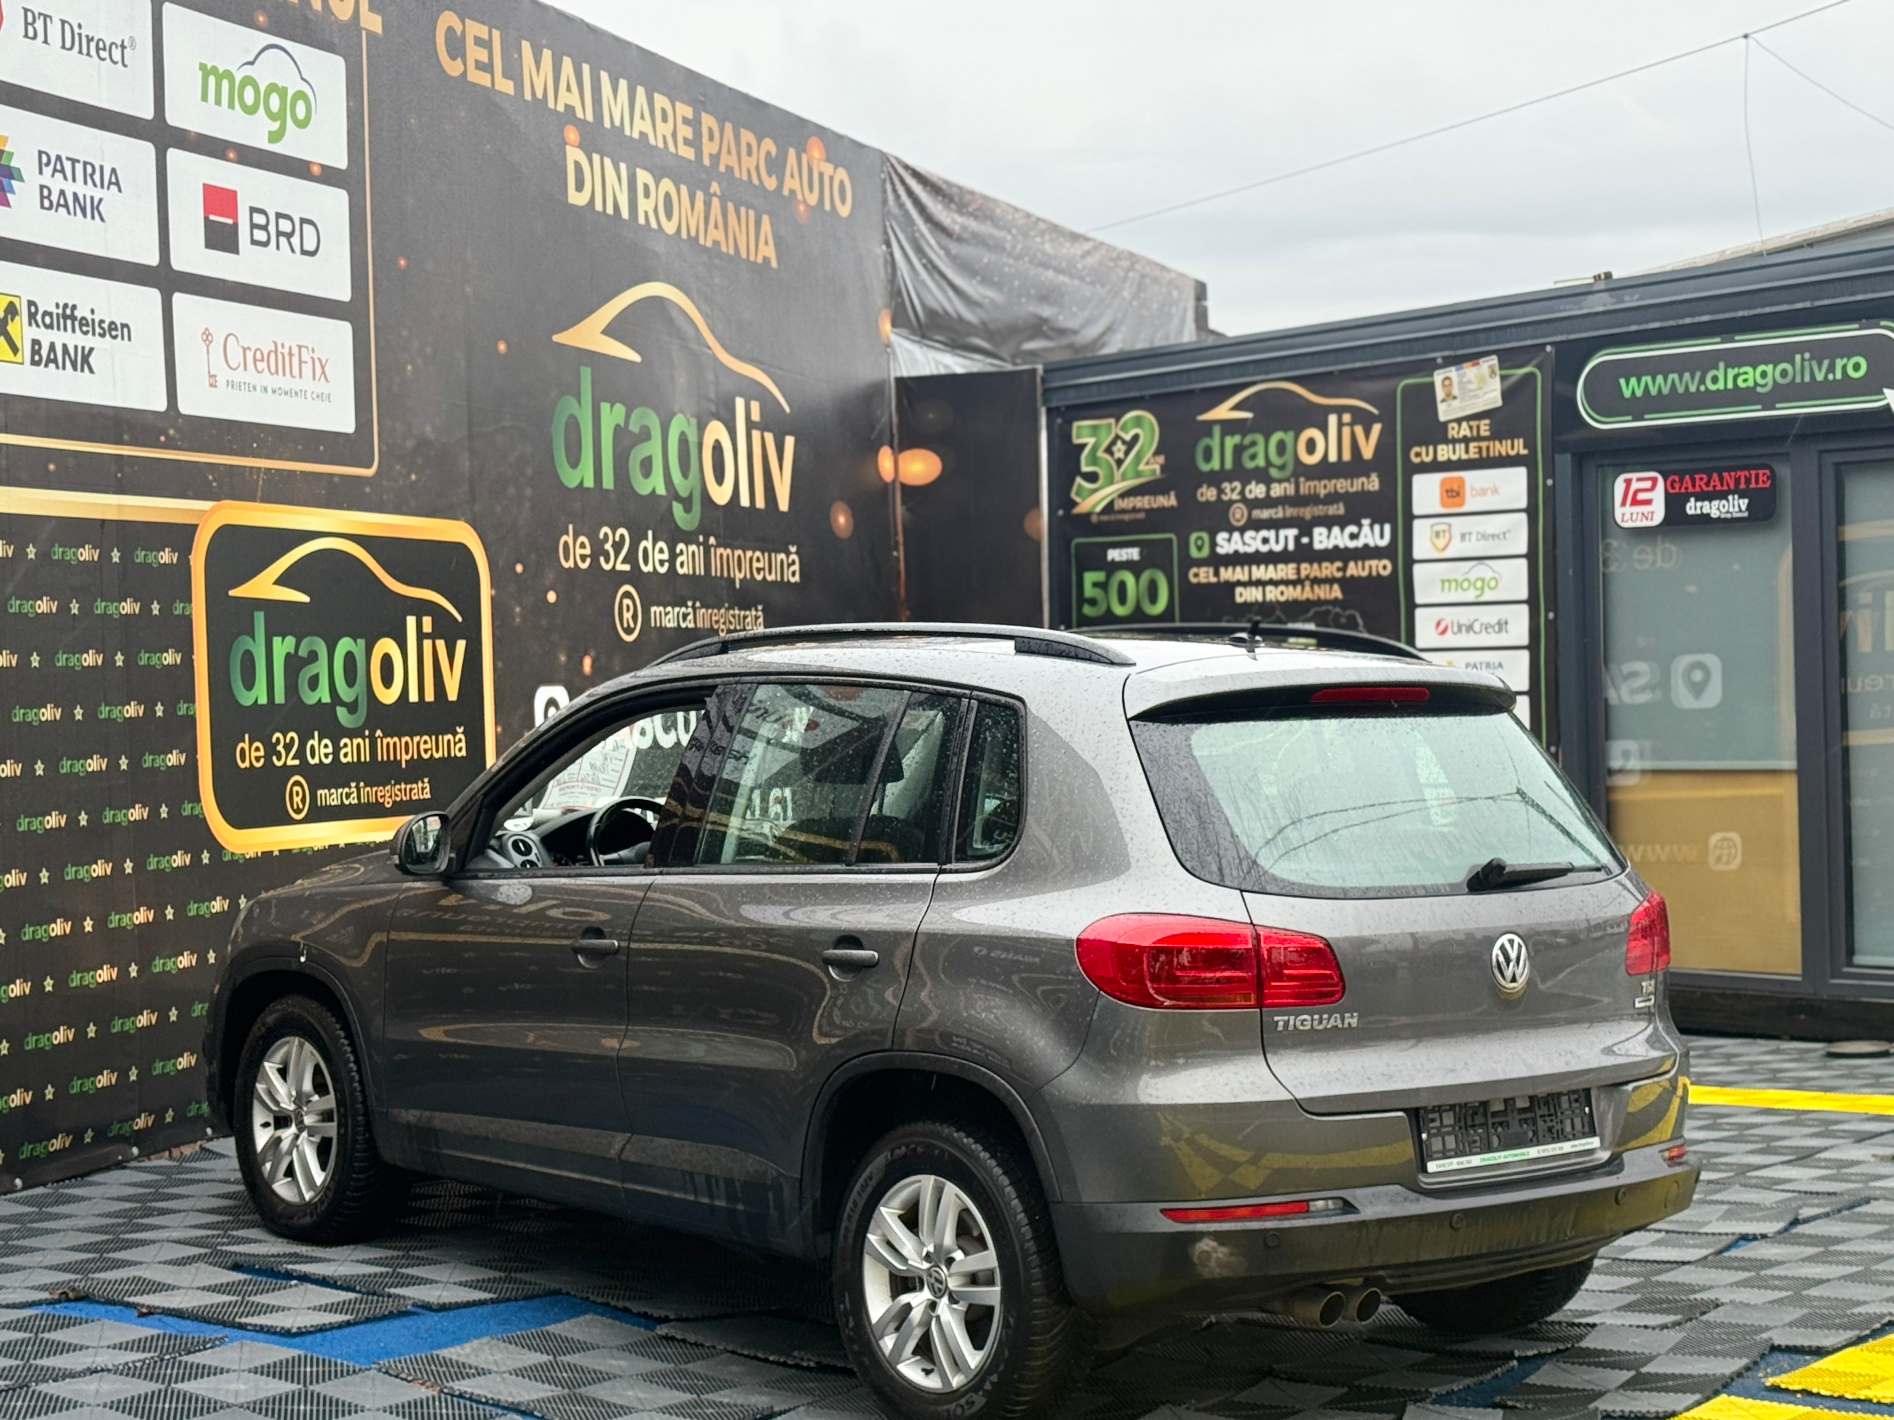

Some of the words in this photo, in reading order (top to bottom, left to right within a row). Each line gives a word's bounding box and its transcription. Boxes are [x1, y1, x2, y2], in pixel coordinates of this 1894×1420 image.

[22, 7, 52, 46] BT
[198, 62, 312, 143] mogo
[435, 10, 514, 96] CEL
[521, 39, 594, 123] MAI
[600, 69, 695, 161] MARE
[701, 111, 777, 191] PARC
[782, 147, 853, 218] AUTO
[37, 149, 123, 194] PATRIA
[38, 184, 106, 223] BANK
[565, 144, 629, 220] DIN
[636, 167, 778, 268] ROMÂNIA
[249, 205, 321, 258] BRD
[27, 299, 132, 343] Raiffeisen
[30, 338, 95, 375] BANK
[222, 332, 330, 384] CreditFix
[226, 380, 257, 394] PRIETEN
[271, 385, 308, 400] MOMENTE
[311, 390, 332, 403] CHEIE
[1619, 351, 1868, 399] www.dragoliv.ro
[1195, 413, 1382, 480] dragoliv
[1447, 420, 1490, 439] RATE
[552, 365, 795, 531] dragoliv
[1410, 445, 1435, 464] CU
[1437, 438, 1529, 461] BULETINUL
[1197, 484, 1217, 502] de
[1221, 481, 1241, 500] 32
[1245, 481, 1266, 499] de
[1270, 478, 1295, 498] ani
[1299, 472, 1379, 498] împreună
[1620, 476, 1659, 508] 12
[1666, 469, 1771, 494] GARANTIE
[1620, 510, 1656, 524] LUNI
[1685, 494, 1749, 518] dragoliv
[51, 543, 100, 564] dragoliv
[133, 547, 178, 567] dragoliv
[1107, 547, 1141, 562] PESTE
[1215, 528, 1299, 555] SASCUT
[1313, 519, 1391, 550] BACĂU
[558, 524, 591, 570] de
[599, 526, 631, 571] 32
[638, 530, 669, 574] de
[676, 535, 705, 576] ani
[710, 536, 800, 589] împreună
[1188, 566, 1218, 584] CEL
[1219, 565, 1251, 582] MAI
[1251, 563, 1299, 582] MARE
[1300, 561, 1343, 580] PARC
[1346, 559, 1392, 578] AUTO
[1081, 568, 1169, 617] 500
[1235, 586, 1264, 603] DIN
[1265, 581, 1343, 602] ROMÂNIA
[1440, 571, 1499, 599] mogo
[7, 597, 58, 617] dragoliv
[93, 598, 141, 618] dragoliv
[650, 601, 694, 628] marcă
[695, 601, 765, 637] înregistrată
[1451, 618, 1509, 636] UniCredit
[54, 649, 103, 670] dragoliv
[137, 649, 182, 668] dragoliv
[229, 610, 467, 729] dragoliv
[11, 703, 62, 725] dragoliv
[97, 701, 144, 721] dragoliv
[59, 754, 108, 774] dragoliv
[141, 749, 186, 770] dragoliv
[235, 734, 265, 769] de
[272, 731, 300, 767] 32
[306, 731, 333, 766] de
[339, 730, 370, 763] ani
[375, 726, 466, 768] împreună
[317, 780, 357, 807] marcă
[358, 777, 431, 808] înregistrată
[16, 811, 67, 833] dragoliv
[102, 805, 149, 826] dragoliv
[64, 859, 113, 882] dragoliv
[146, 850, 191, 872] dragoliv
[21, 918, 72, 942] dragoliv
[107, 907, 155, 930] dragoliv
[186, 896, 230, 917] dragoliv
[0, 978, 31, 1001] goliv
[68, 965, 118, 988] dragoliv
[151, 951, 197, 973] dragoliv
[24, 1025, 75, 1050] dragoliv
[110, 1009, 158, 1033] dragoliv
[1273, 1012, 1359, 1031] TIGUAN
[69, 1069, 118, 1094] dragoliv
[152, 1052, 197, 1075] dragoliv
[19, 1132, 74, 1160] dragoliv
[107, 1112, 155, 1137] dragoliv
